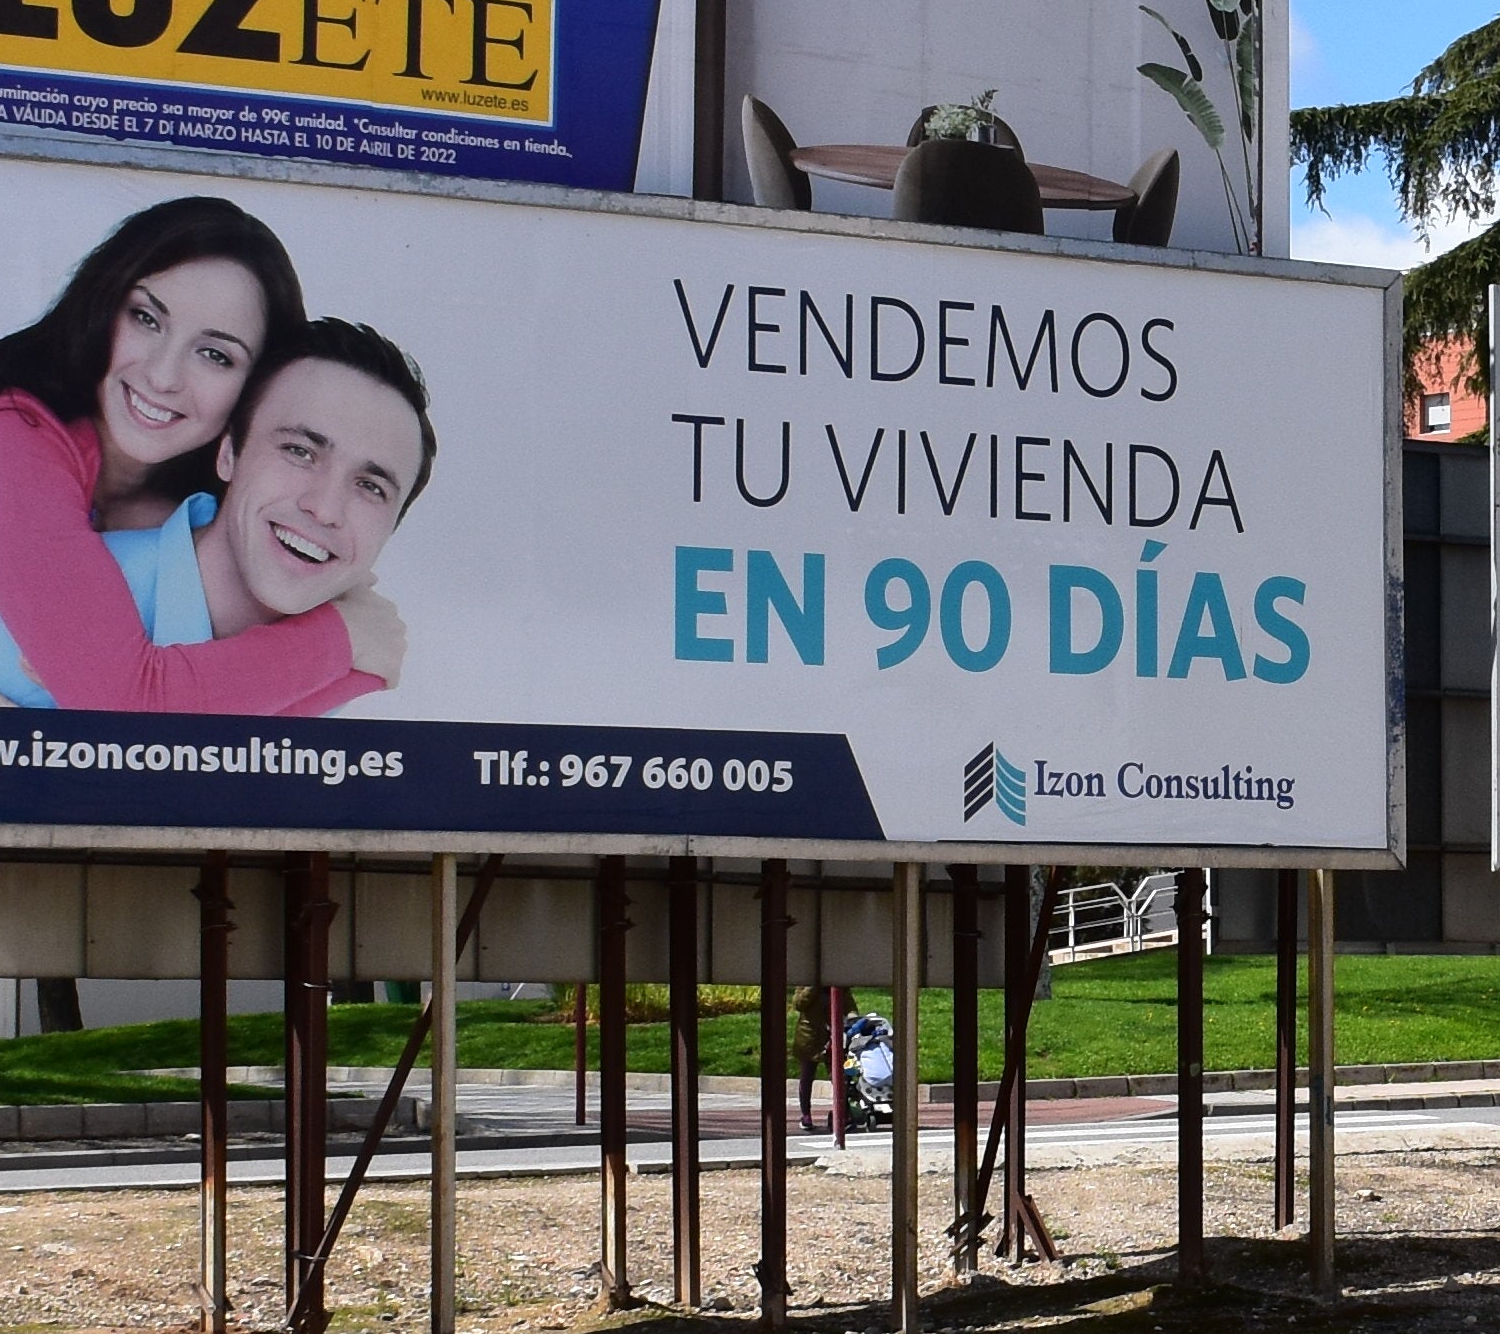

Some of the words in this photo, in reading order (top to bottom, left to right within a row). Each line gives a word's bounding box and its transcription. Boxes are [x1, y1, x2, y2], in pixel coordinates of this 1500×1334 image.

[73, 94, 109, 112] cuyo
[113, 96, 158, 115] precio
[188, 104, 236, 123] mayor
[239, 106, 258, 123] de
[261, 108, 291, 127] 99€
[295, 113, 348, 133] unidad.
[422, 128, 500, 150] condiciones
[503, 138, 521, 152] en
[421, 86, 529, 113] www.luzete.es
[12, 103, 67, 127] VÁLIDA
[71, 110, 120, 132] DESDE
[124, 117, 140, 133] EL
[144, 119, 154, 134] 7
[178, 120, 237, 142] MARZO
[241, 128, 290, 147] HASTA
[295, 133, 311, 149] EL
[315, 134, 333, 151] 10
[336, 137, 356, 154] DE
[397, 144, 417, 161] DE
[420, 148, 458, 165] 2022
[673, 277, 1178, 403] VENDEMOS
[671, 412, 792, 509] TU
[825, 423, 1246, 535] VIVIENDA
[673, 545, 825, 668] EN
[862, 556, 1013, 674] 90
[1048, 539, 1313, 686] DÍAS
[473, 749, 551, 788] Tlf.:
[559, 753, 632, 793] 967
[642, 755, 713, 793] 660
[721, 757, 794, 795] 005
[1033, 757, 1107, 800] Izon
[1116, 762, 1296, 812] Consulting
